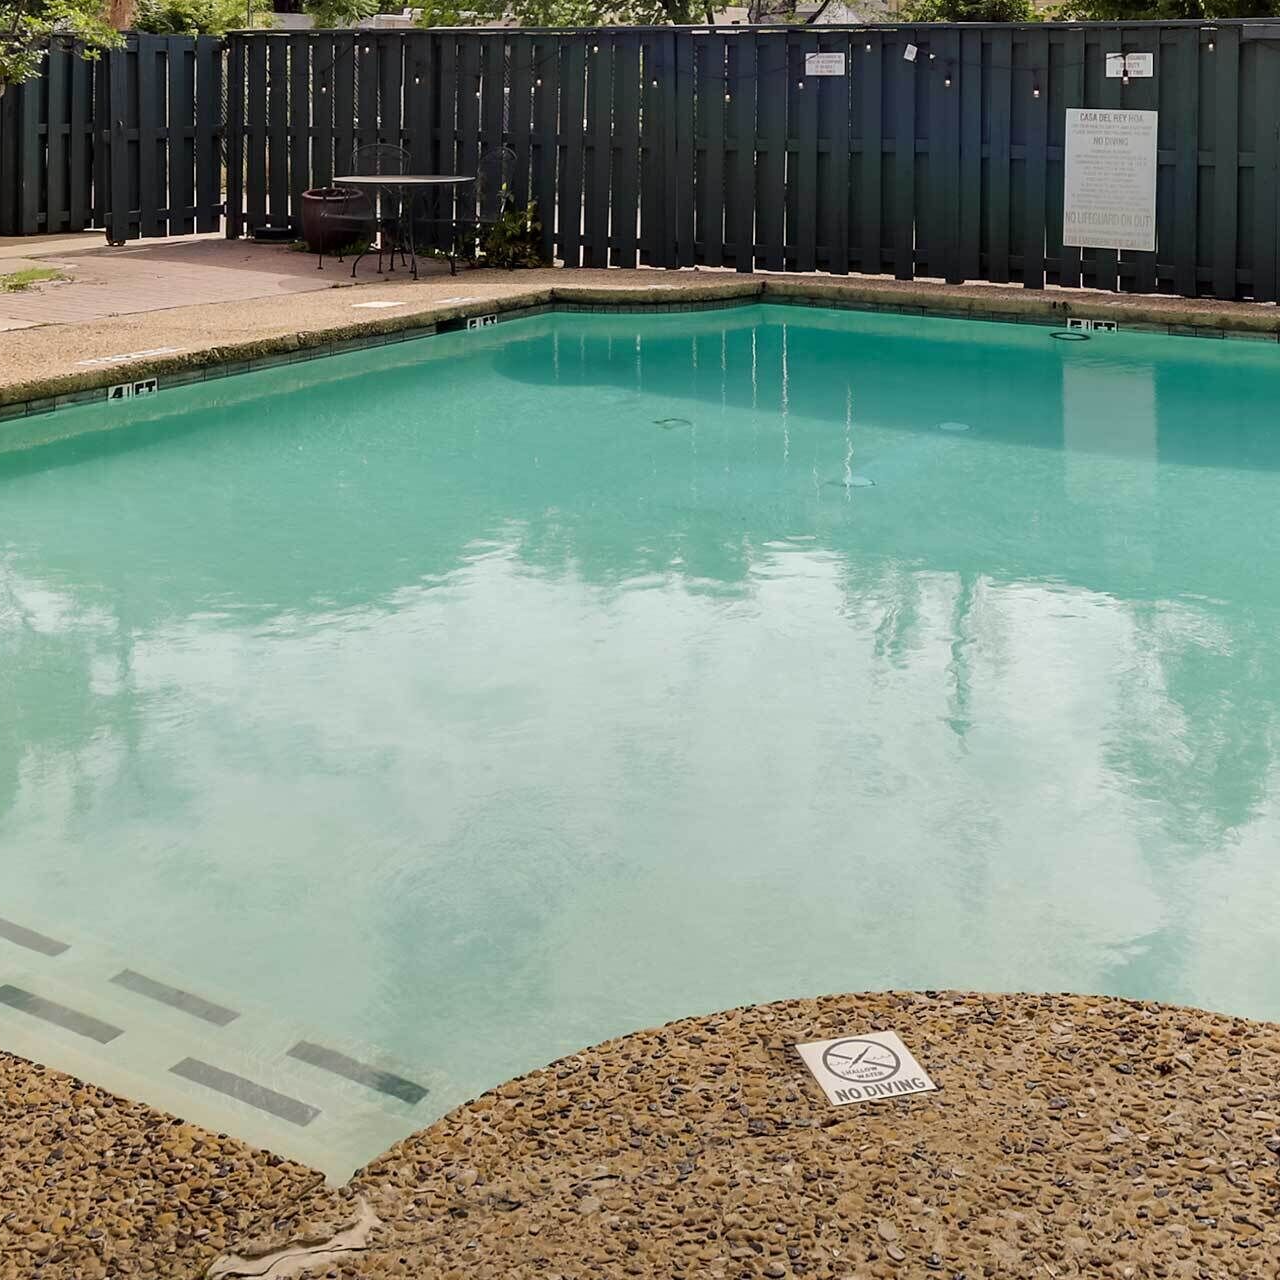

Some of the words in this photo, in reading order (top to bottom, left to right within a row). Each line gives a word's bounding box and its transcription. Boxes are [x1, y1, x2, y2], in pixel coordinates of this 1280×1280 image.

[1080, 113, 1097, 122] CASA
[1099, 114, 1111, 122] DEL
[1093, 136, 1104, 145] NO
[1105, 136, 1129, 146] DIVING
[1065, 212, 1076, 224] NO
[1077, 212, 1119, 225] LIFEGUARD
[1121, 215, 1133, 226] ON
[1134, 216, 1152, 228] DUTY
[135, 380, 156, 395] FT
[841, 1066, 878, 1076] SHALLOW
[856, 1071, 885, 1079] WATER
[834, 1087, 862, 1102] NO
[865, 1077, 926, 1098] DIVING
